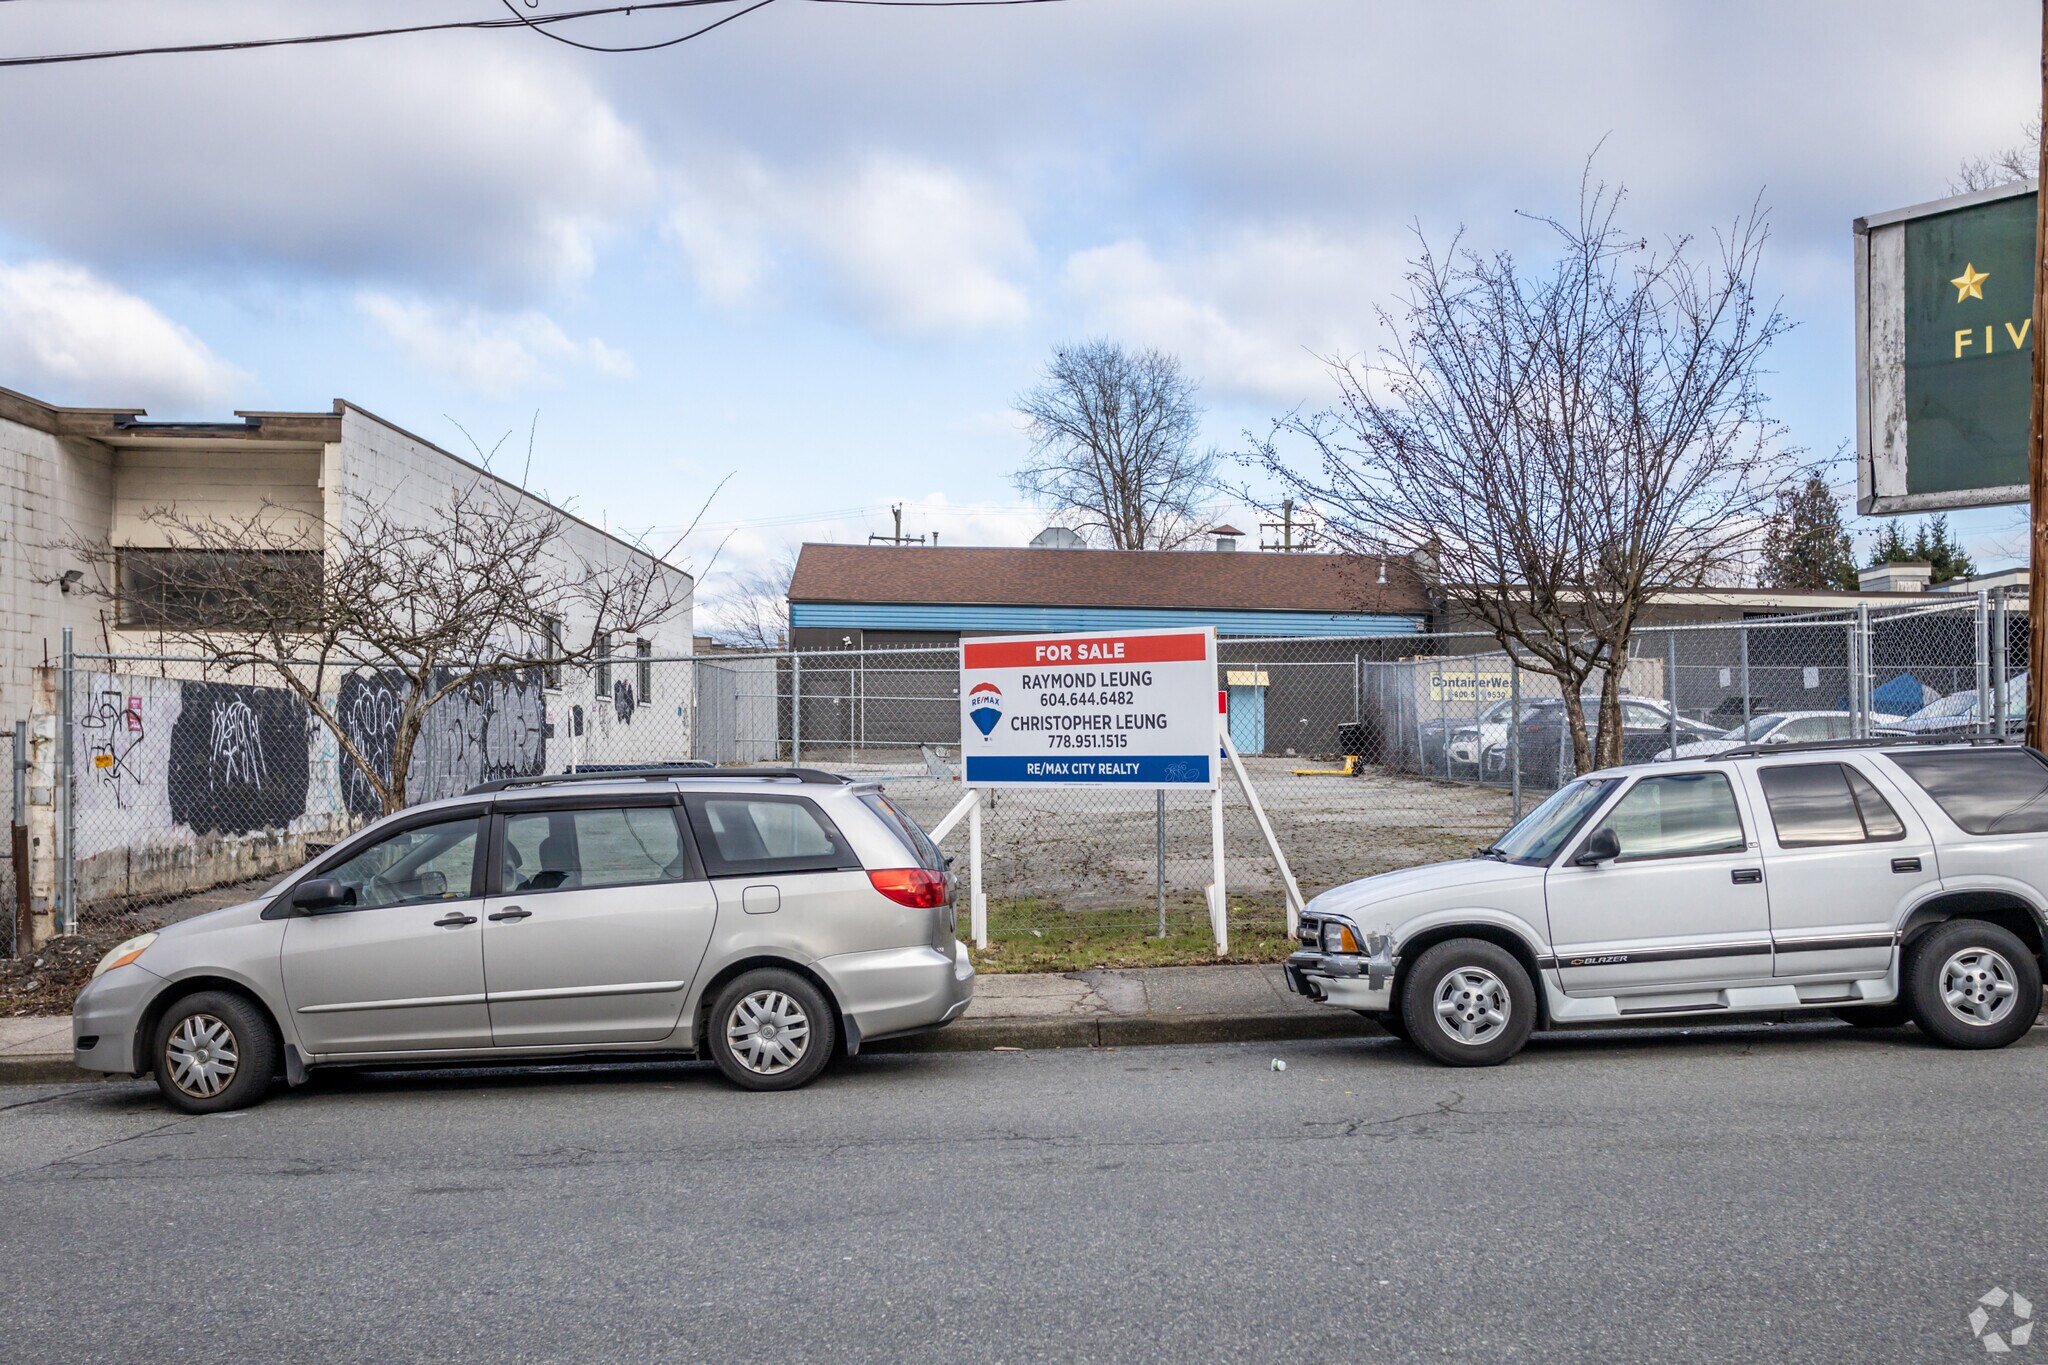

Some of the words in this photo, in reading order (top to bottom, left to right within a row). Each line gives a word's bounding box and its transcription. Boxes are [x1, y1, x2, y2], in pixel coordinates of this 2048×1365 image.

[1955, 318, 2031, 358] FIV
[1035, 646, 1072, 661] FOR
[1077, 642, 1125, 660] SALE
[1022, 672, 1096, 690] RAYMOND
[1101, 670, 1152, 688] LEUNG
[971, 696, 1000, 706] RE/MAX
[1040, 691, 1134, 707] 604.644.6482
[1010, 715, 1112, 731] CHRISTOPHER
[1116, 713, 1168, 730] LEUNG
[1048, 734, 1128, 749] 778.951.1515
[1026, 762, 1069, 776] RE/MAX
[1071, 763, 1095, 775] CITY
[1098, 762, 1140, 775] REALTY
[1584, 956, 1628, 964] BLAZER
